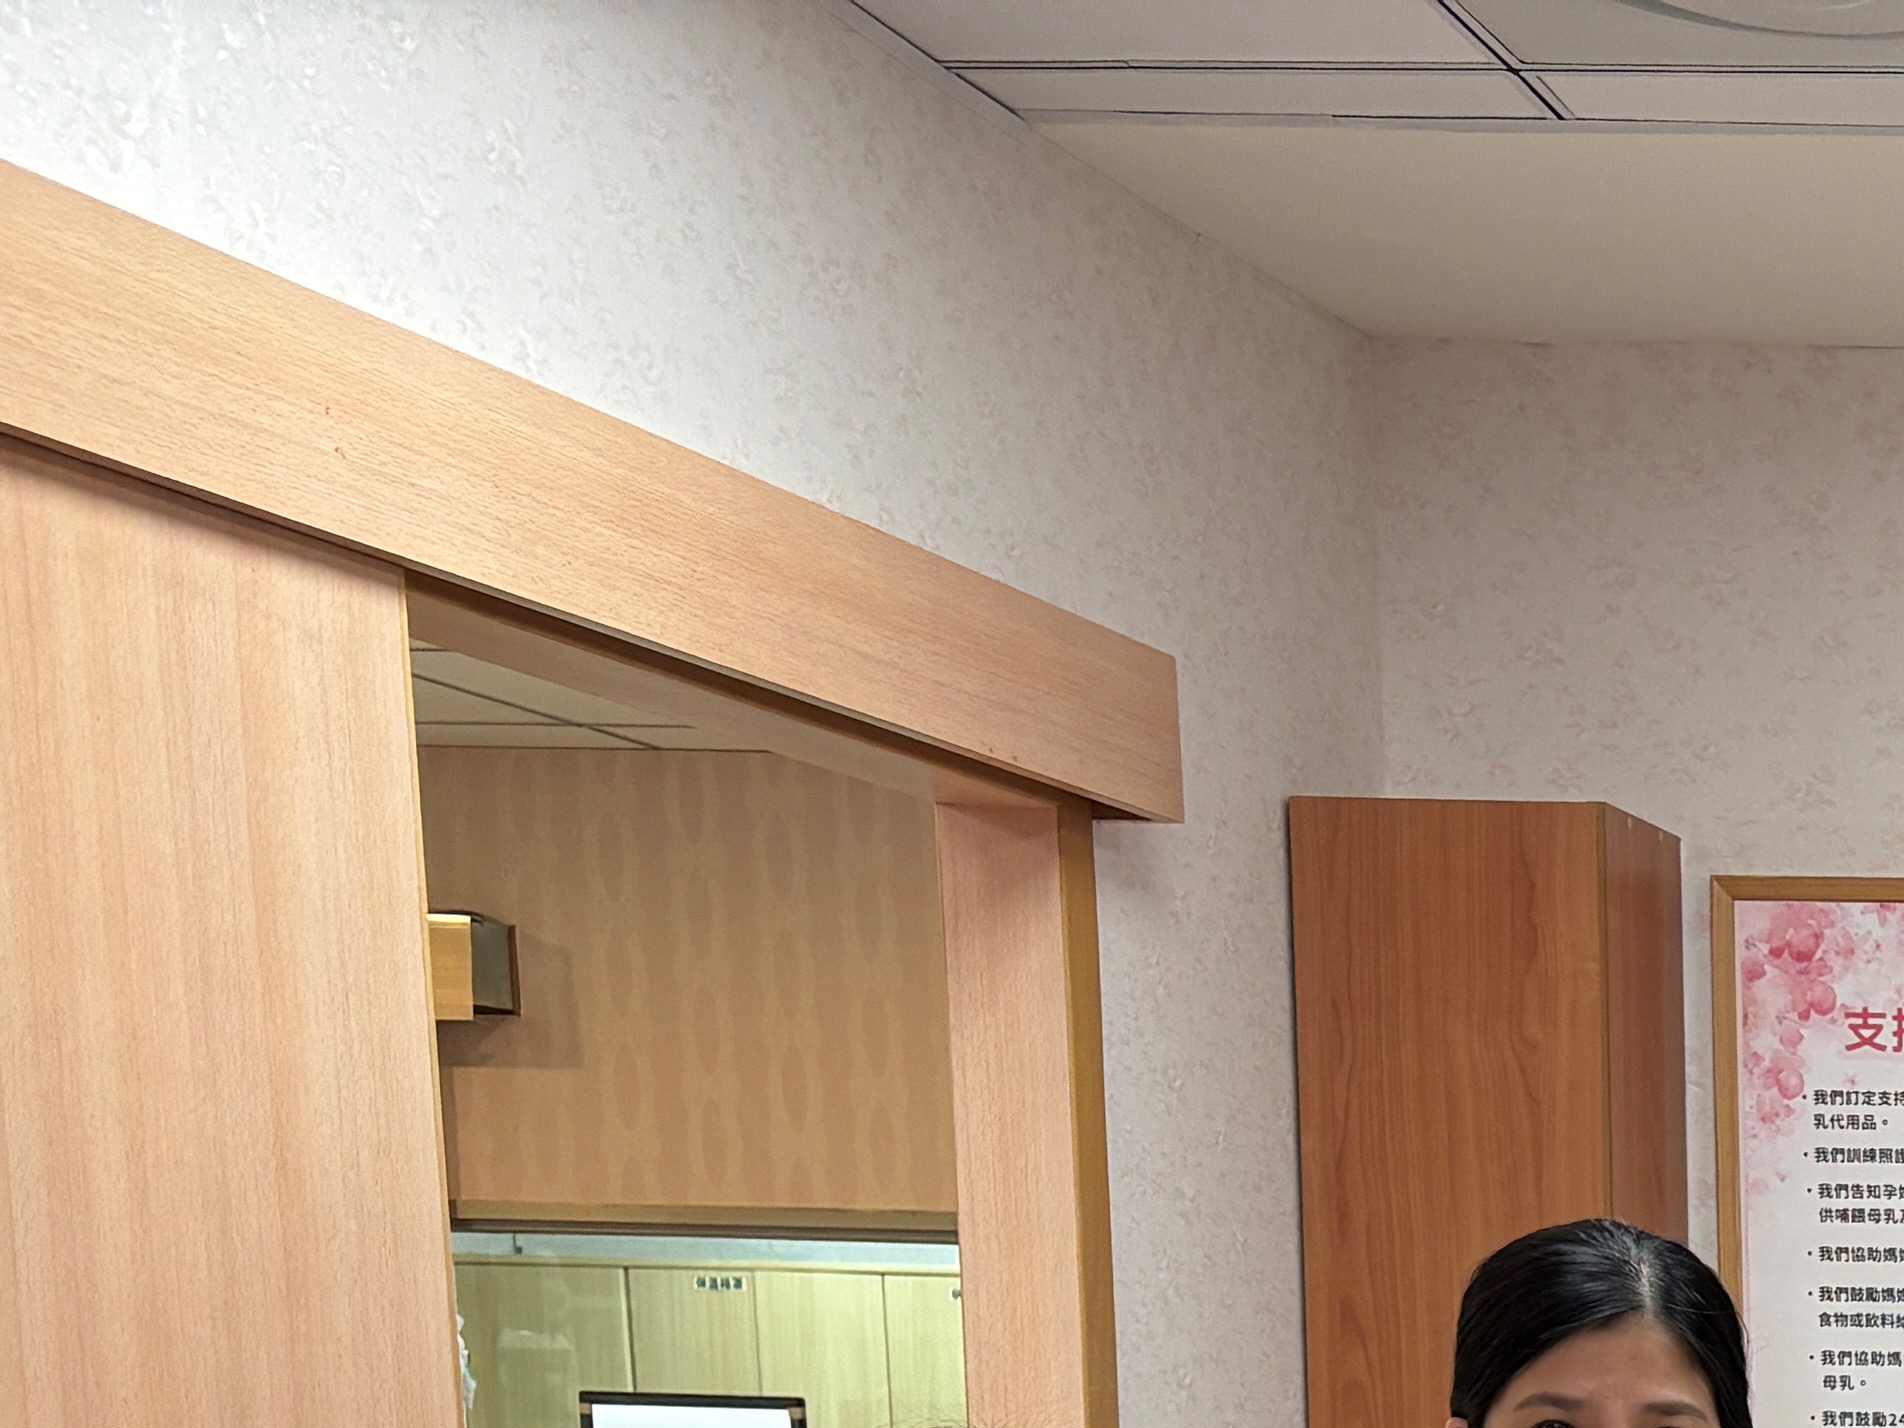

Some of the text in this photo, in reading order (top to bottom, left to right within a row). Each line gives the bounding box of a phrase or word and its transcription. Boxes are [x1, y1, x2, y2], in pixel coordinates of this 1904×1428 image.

[1813, 1114, 1888, 1131] 乳代用品。
[1823, 1376, 1867, 1391] 母乳。
